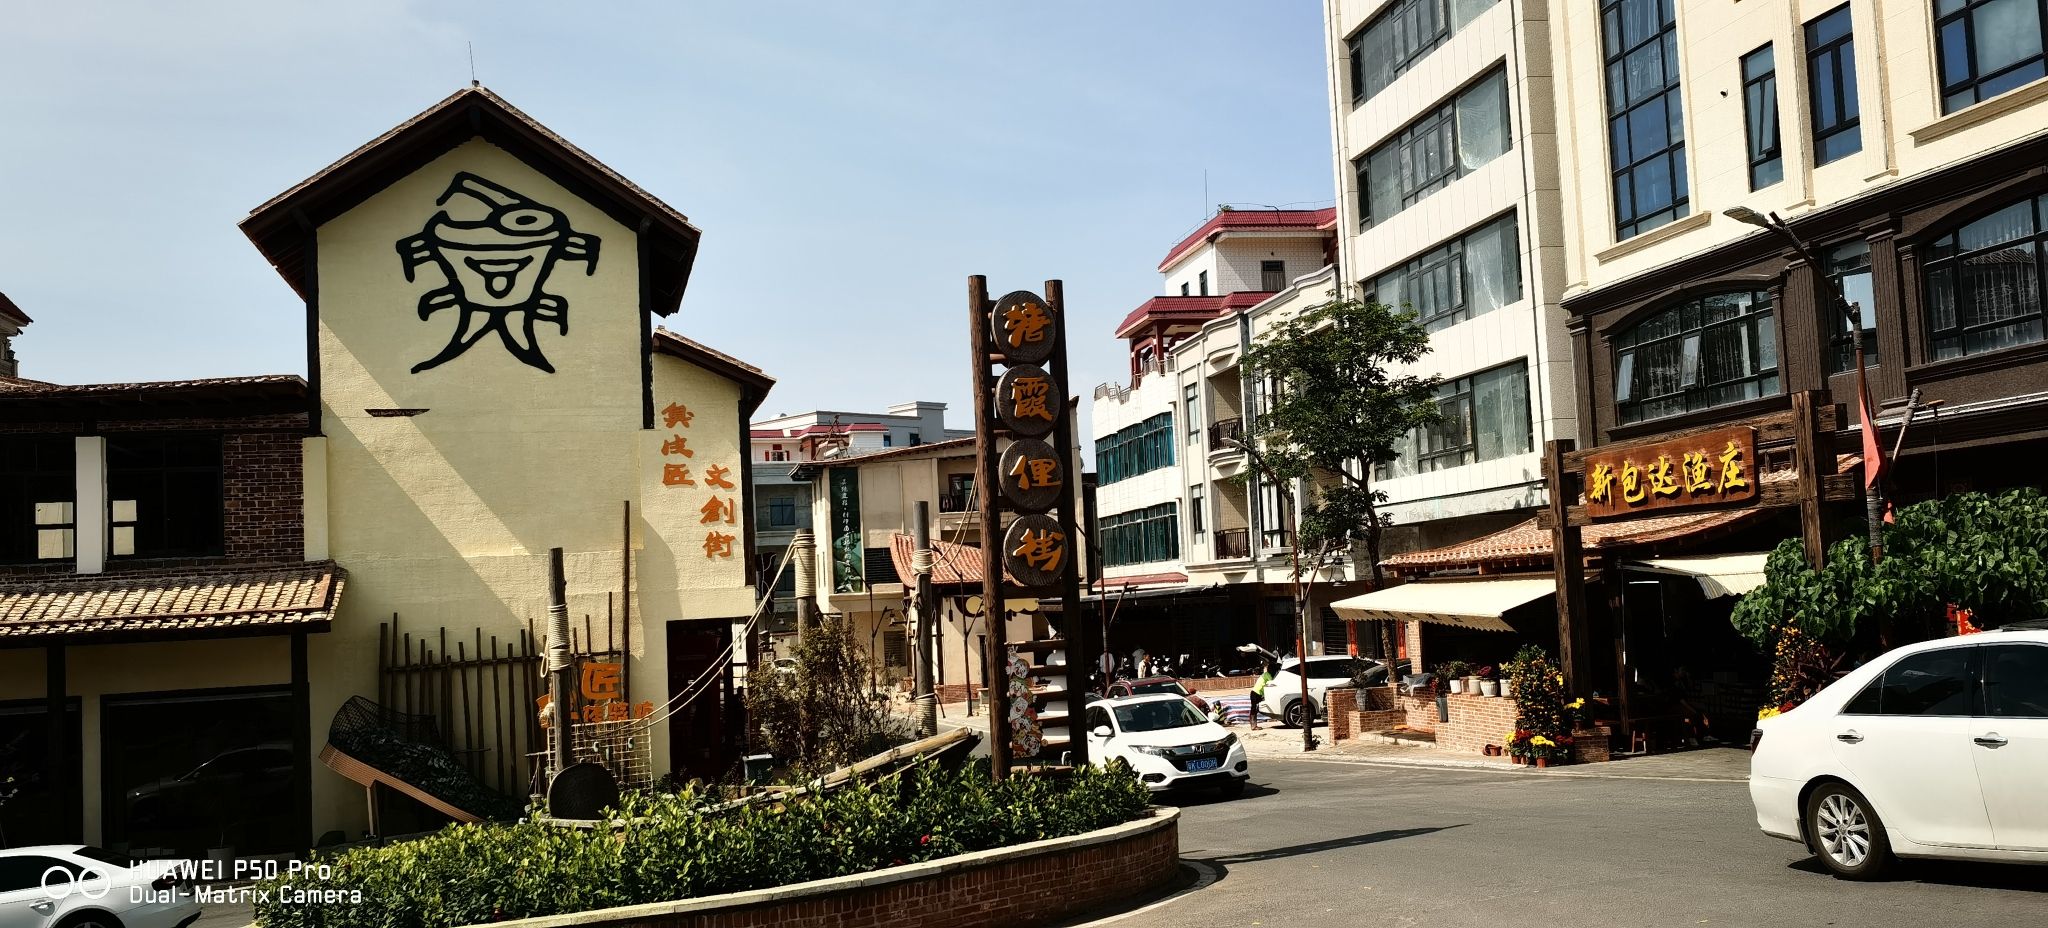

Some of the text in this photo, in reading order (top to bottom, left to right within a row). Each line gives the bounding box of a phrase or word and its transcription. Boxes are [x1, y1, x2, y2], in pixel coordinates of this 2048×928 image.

[1590, 441, 1745, 506] 新包达渔庄
